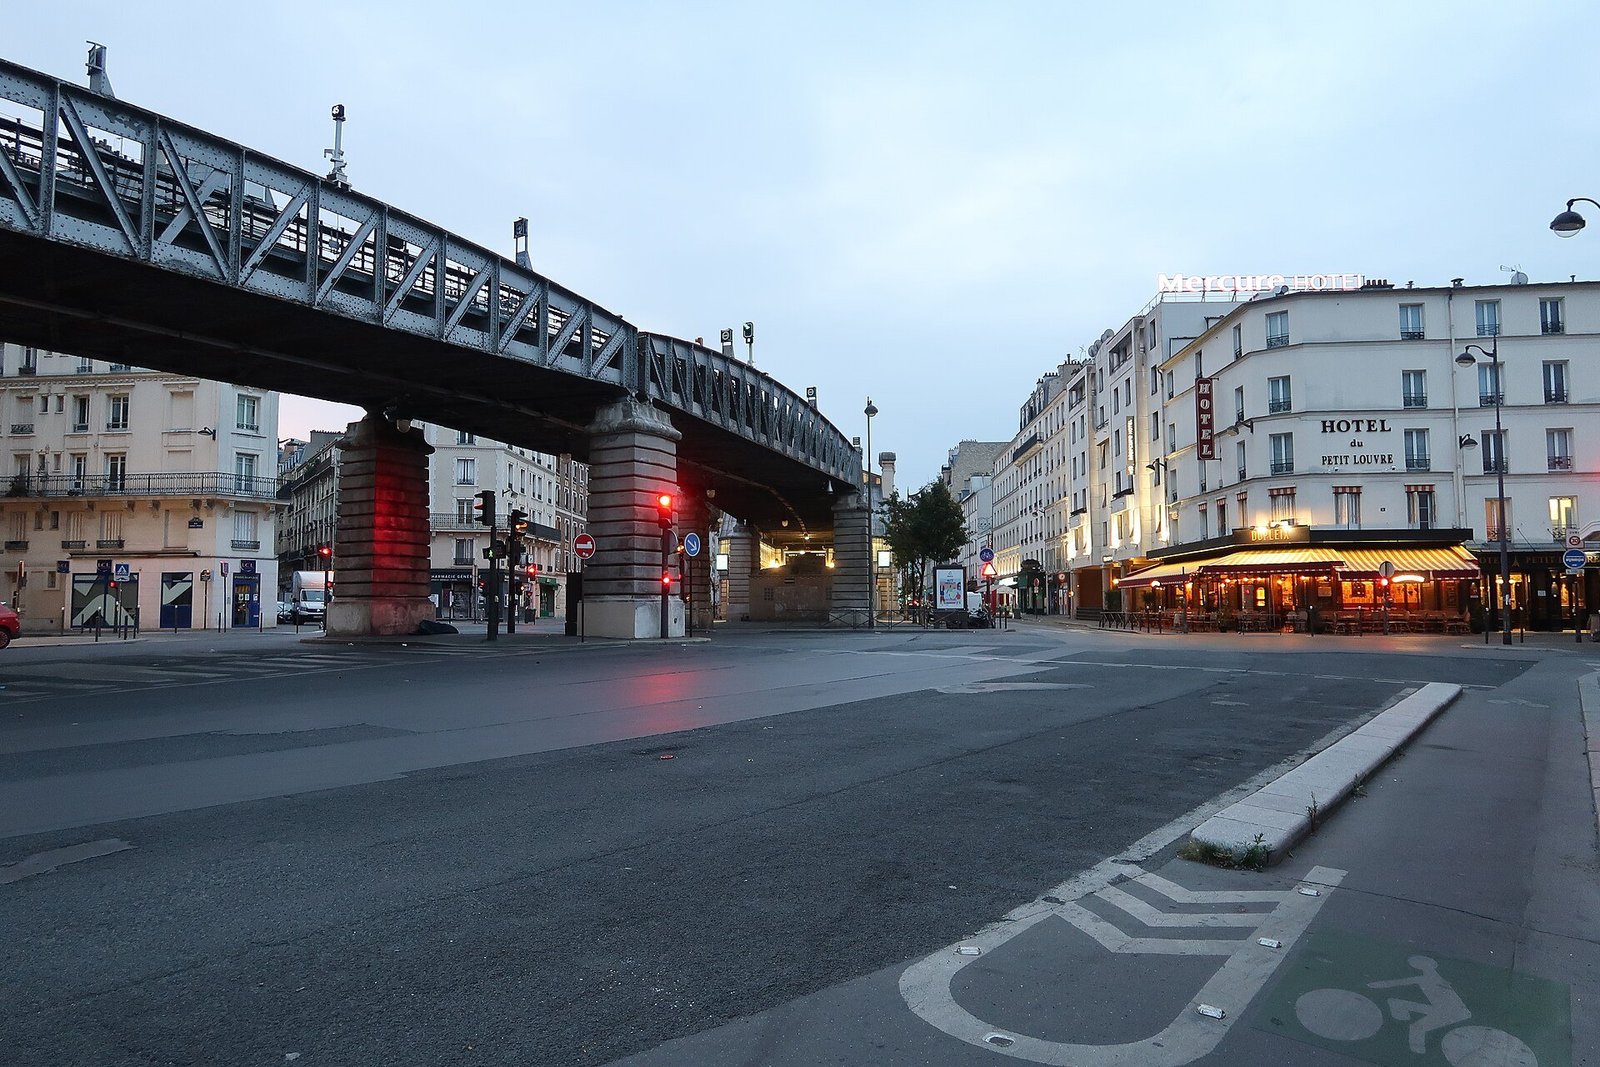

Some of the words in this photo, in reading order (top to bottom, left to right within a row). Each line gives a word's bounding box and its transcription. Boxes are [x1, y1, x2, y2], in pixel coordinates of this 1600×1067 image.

[1157, 273, 1285, 292] Mercure
[1199, 383, 1211, 456] HOTEL
[1321, 419, 1392, 433] HOTEL
[1350, 439, 1363, 447] du
[1321, 455, 1350, 466] PETIT
[1353, 454, 1394, 465] LOUVRE
[1251, 529, 1290, 541] DUPLEIX
